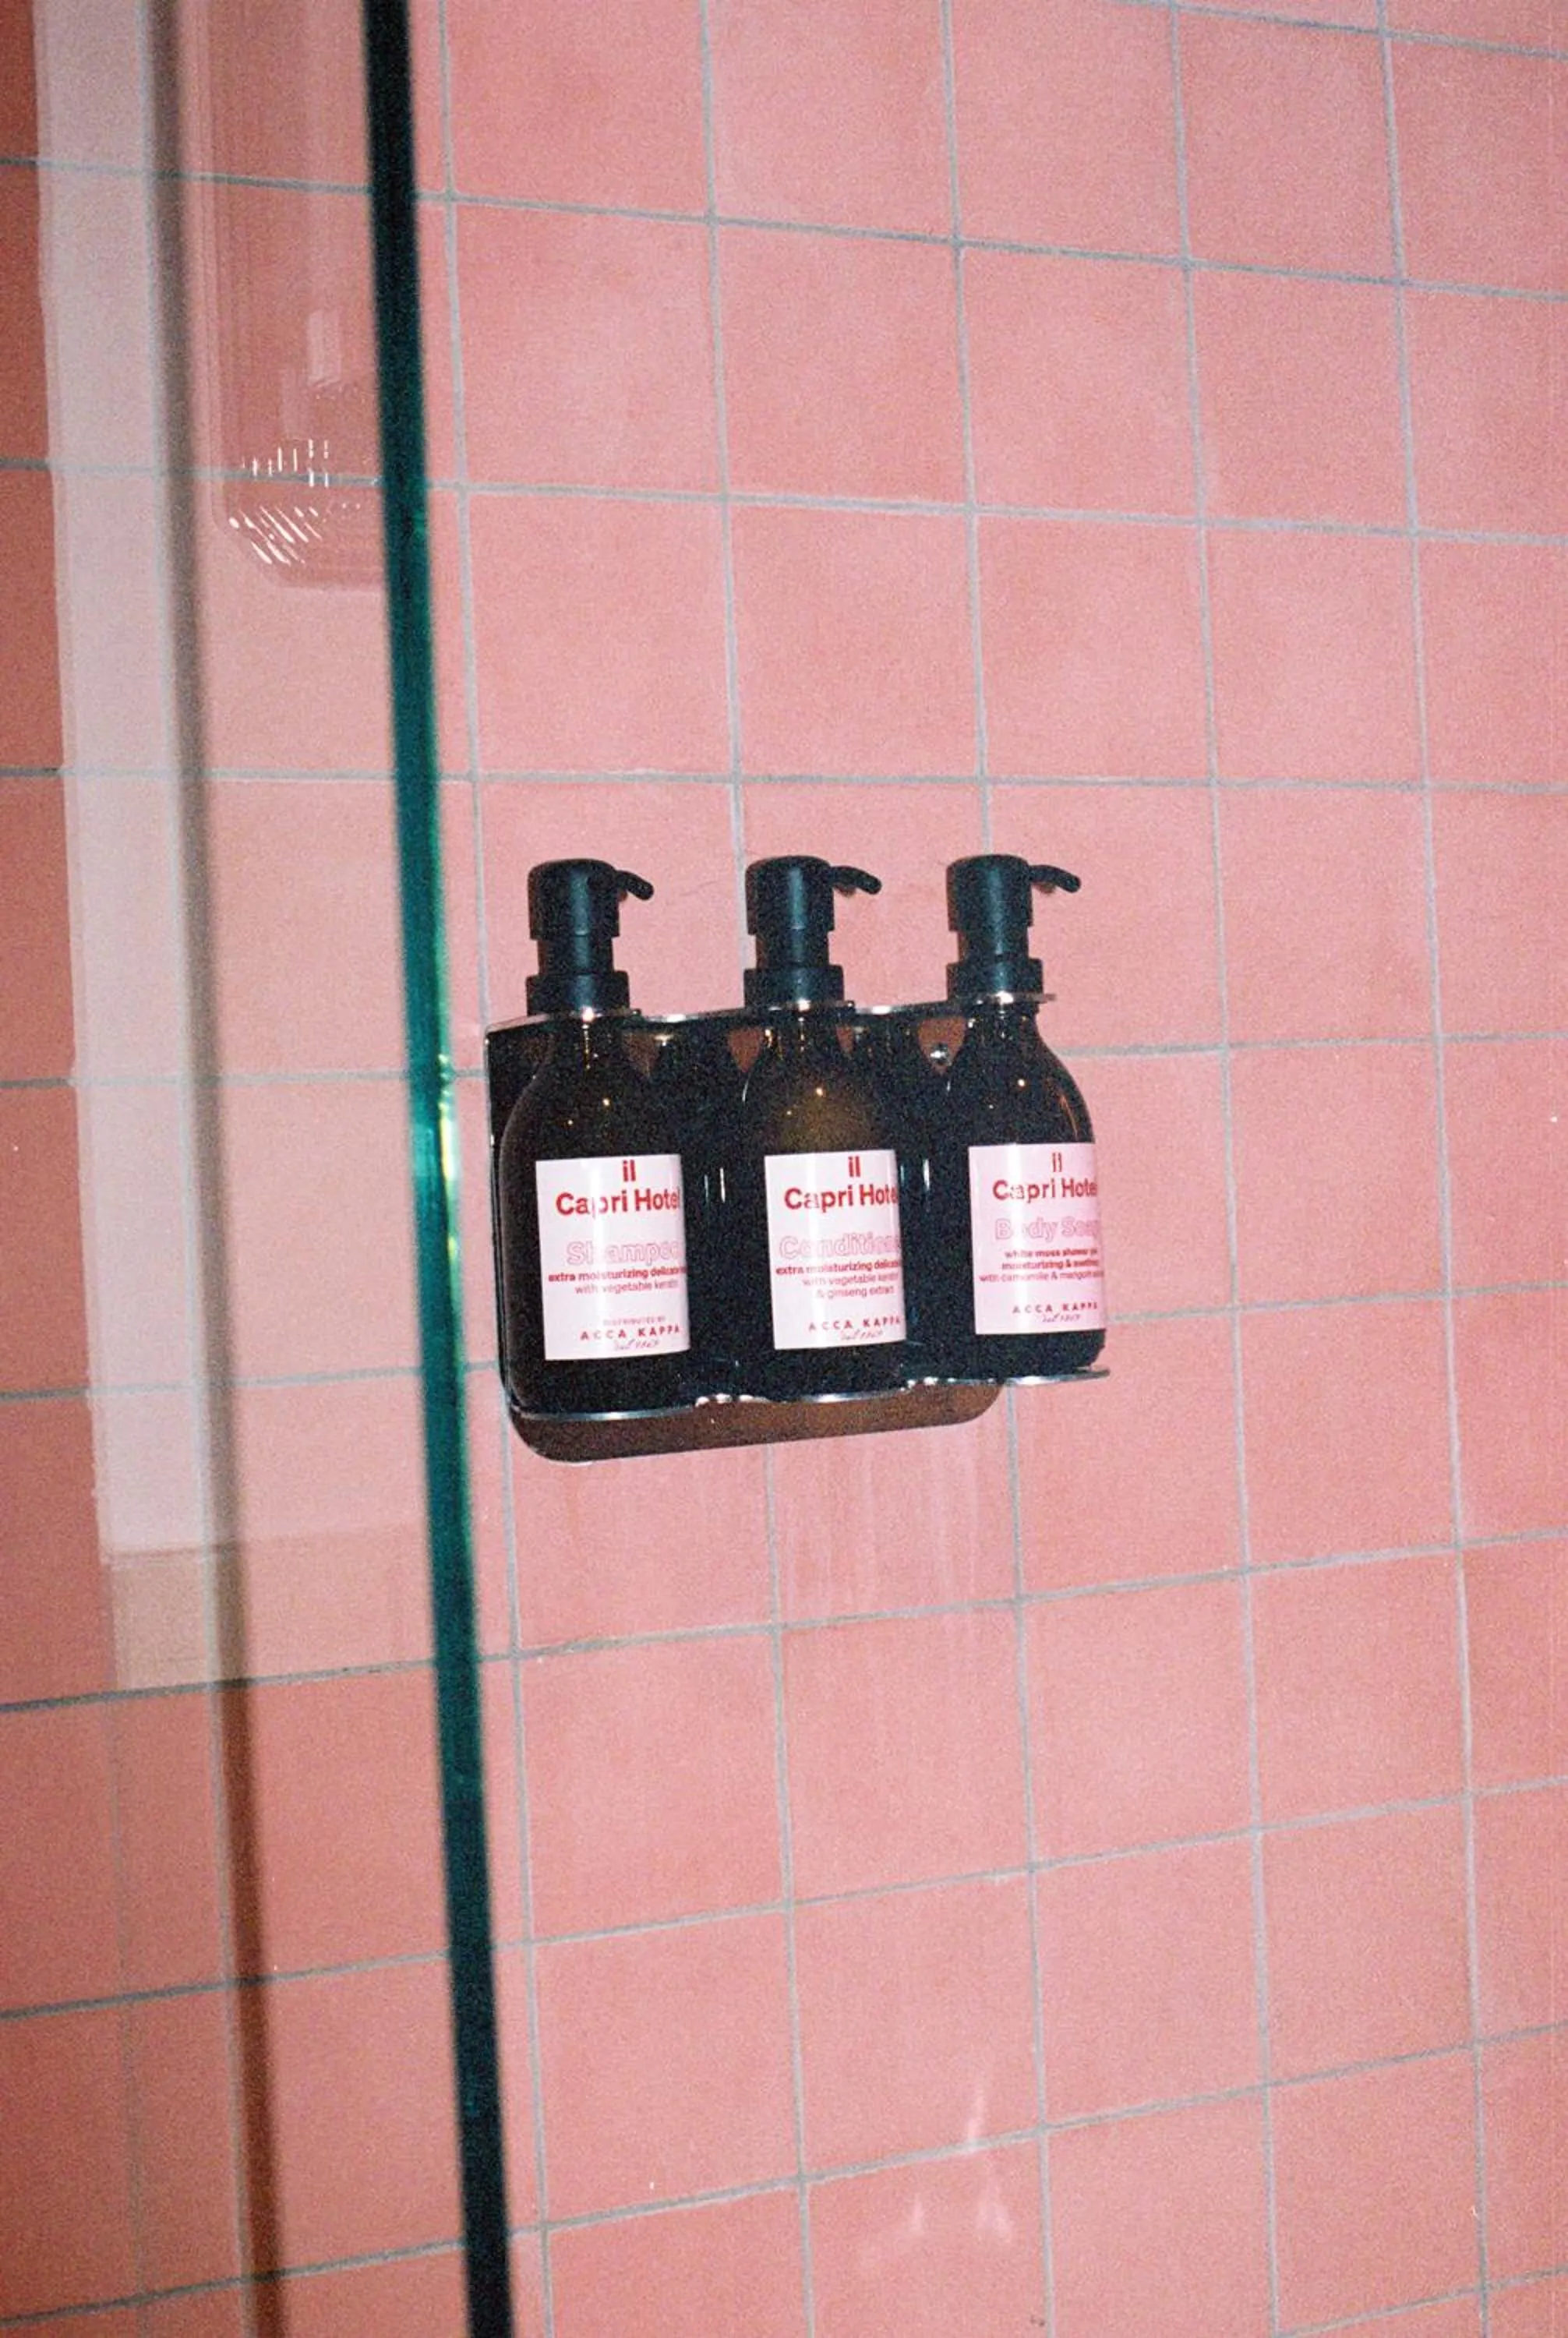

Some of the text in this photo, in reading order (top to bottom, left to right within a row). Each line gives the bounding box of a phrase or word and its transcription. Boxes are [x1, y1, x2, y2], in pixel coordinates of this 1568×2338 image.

[622, 1159, 637, 1182] il
[848, 1156, 860, 1178] il
[785, 1185, 854, 1213] Capri
[993, 1178, 1056, 1203] Capri
[556, 1189, 628, 1219] Capri
[995, 1217, 1058, 1242] Bdy
[549, 1272, 576, 1283] extra
[775, 1266, 804, 1276] extra
[574, 1283, 599, 1294] with
[1012, 1303, 1054, 1314] ACCA
[580, 1323, 680, 1340] ACCA KAPPA
[809, 1319, 853, 1331] ACCA
